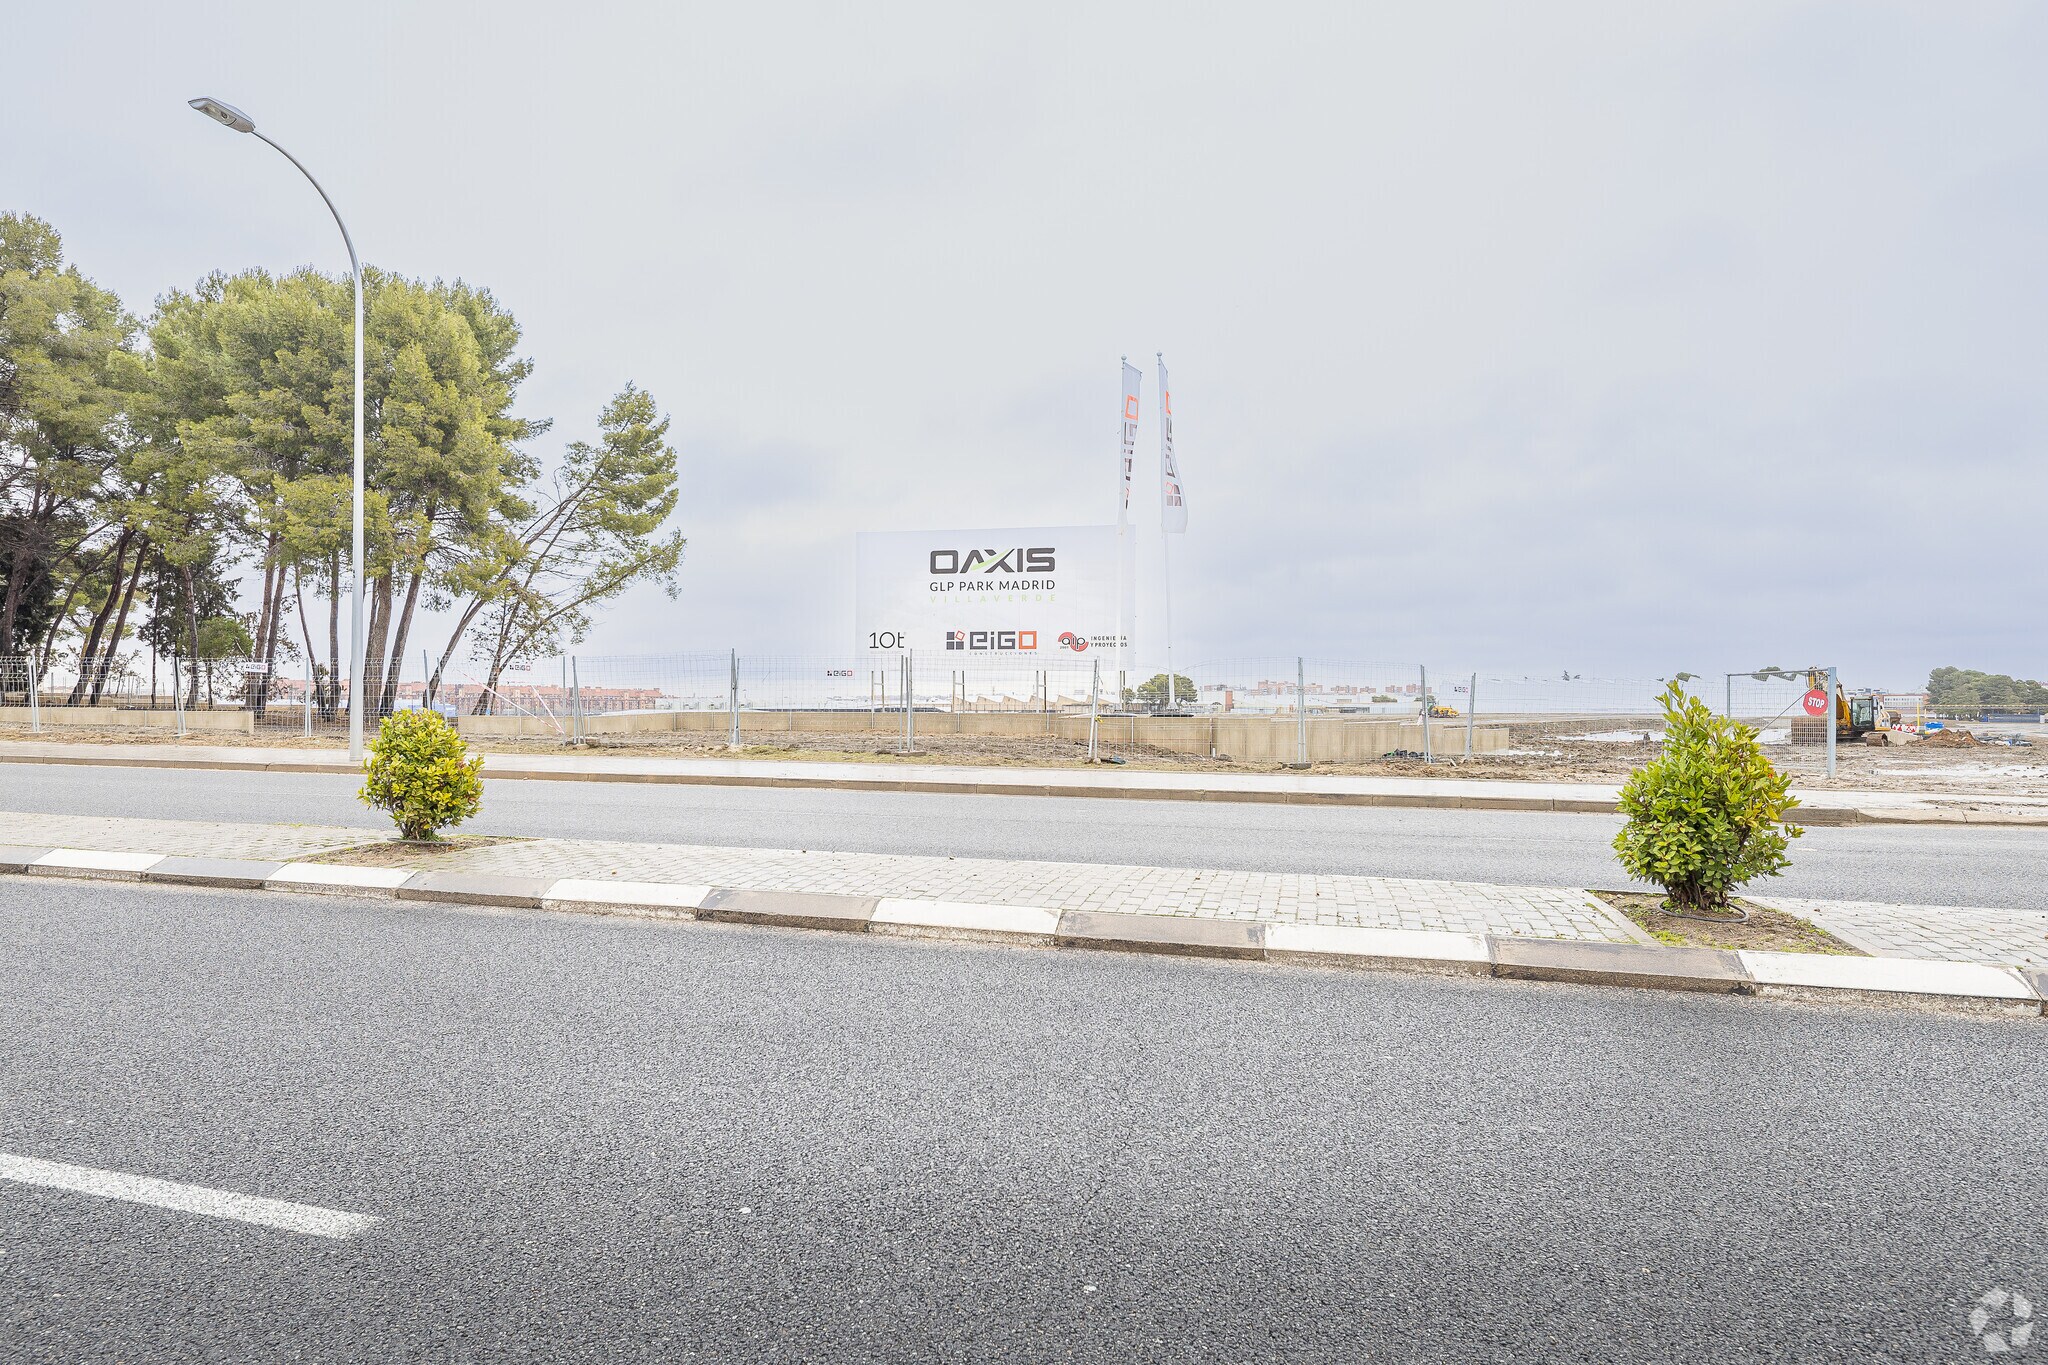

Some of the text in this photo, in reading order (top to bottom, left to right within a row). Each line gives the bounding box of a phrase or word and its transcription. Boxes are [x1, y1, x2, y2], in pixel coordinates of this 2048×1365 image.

[930, 547, 1056, 574] OAXIS
[929, 579, 1056, 592] GLP PARK MADRID
[929, 594, 1056, 604] VILLAVERDE
[1808, 696, 1825, 708] STOP
